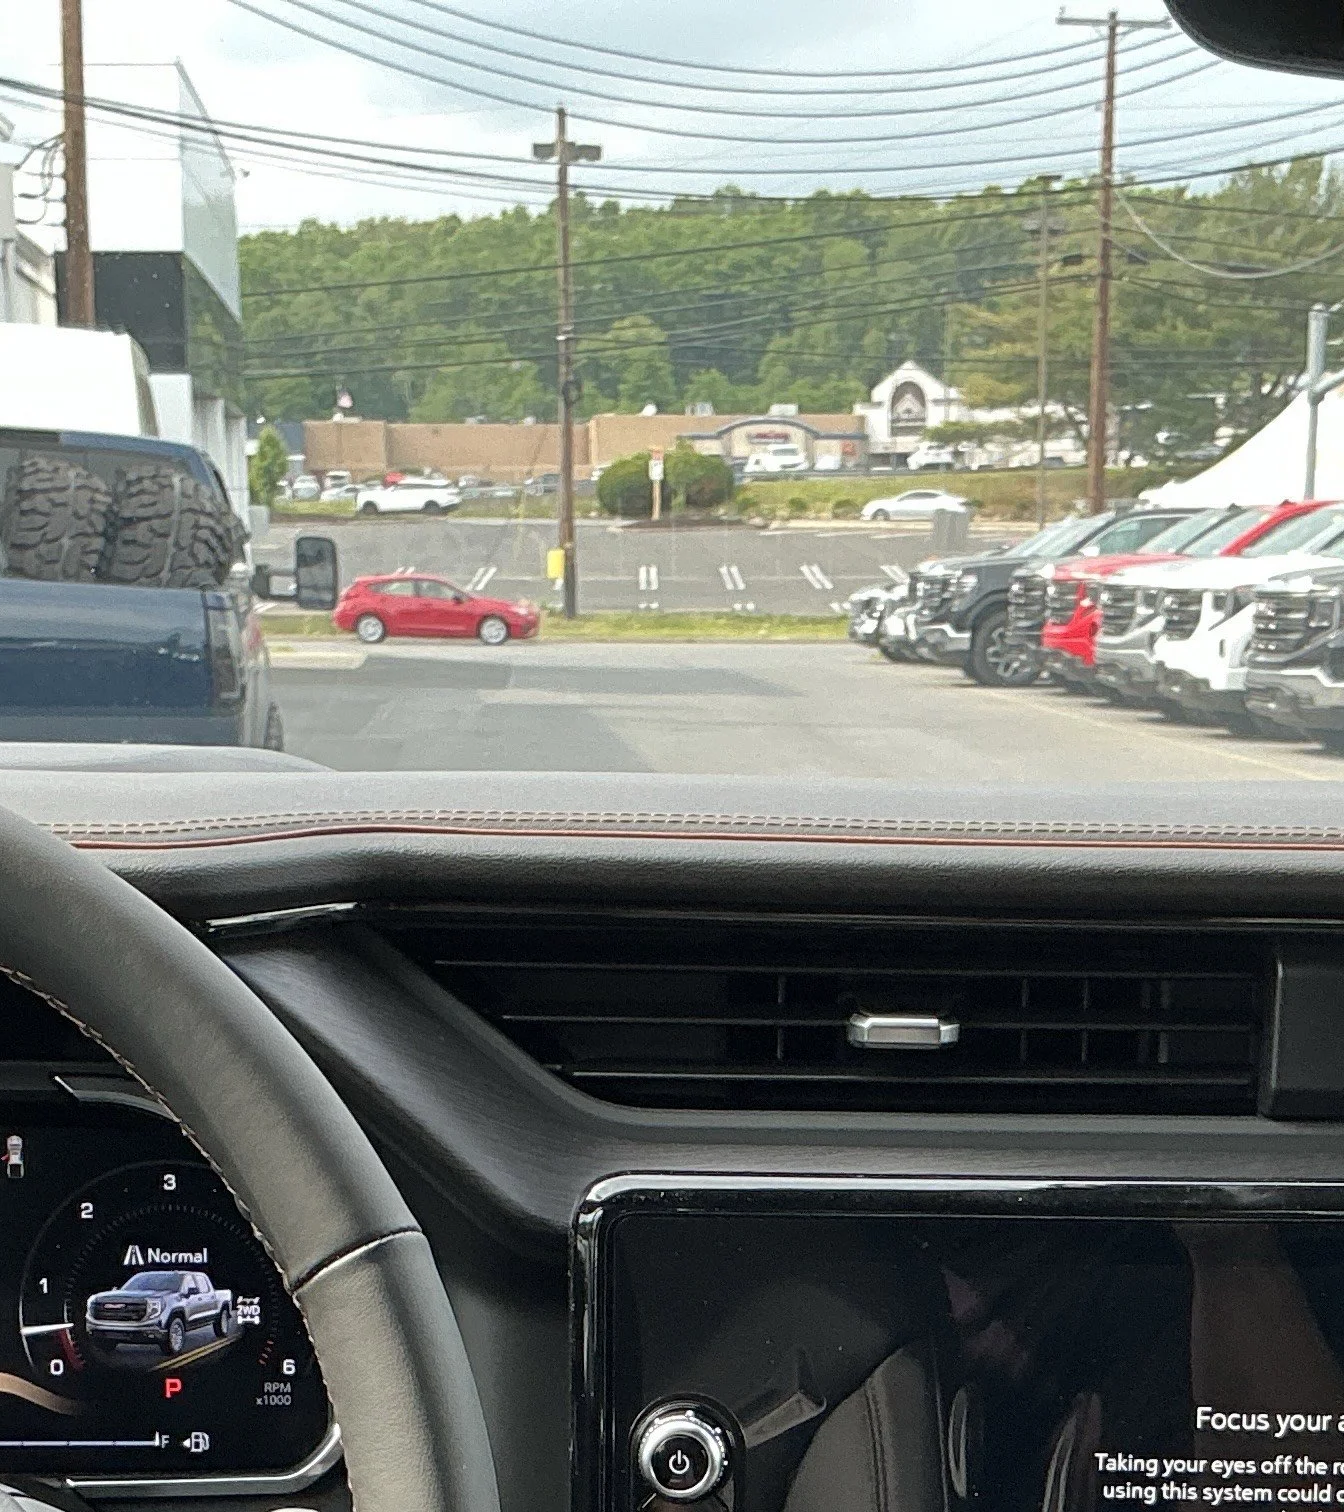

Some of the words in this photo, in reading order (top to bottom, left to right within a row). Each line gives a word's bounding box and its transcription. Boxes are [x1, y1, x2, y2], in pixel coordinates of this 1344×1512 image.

[163, 1174, 177, 1191] 3
[80, 1203, 93, 1219] 2
[147, 1247, 208, 1264] Normal
[39, 1278, 48, 1293] 1
[50, 1359, 64, 1375] 0
[282, 1359, 296, 1375] 6
[165, 1378, 182, 1398] P
[264, 1382, 291, 1393] RPM
[256, 1394, 291, 1406] x1000
[1196, 1406, 1269, 1431] Focus
[1274, 1411, 1333, 1438] your
[161, 1434, 170, 1448] F
[1094, 1452, 1158, 1477] Taking
[1162, 1458, 1208, 1477] your
[1211, 1459, 1256, 1478] eyes
[1260, 1455, 1292, 1474] off
[1295, 1455, 1328, 1475] the
[1103, 1482, 1156, 1505] using
[1160, 1482, 1198, 1500] this
[1202, 1486, 1273, 1506] system
[1277, 1483, 1332, 1503] could
